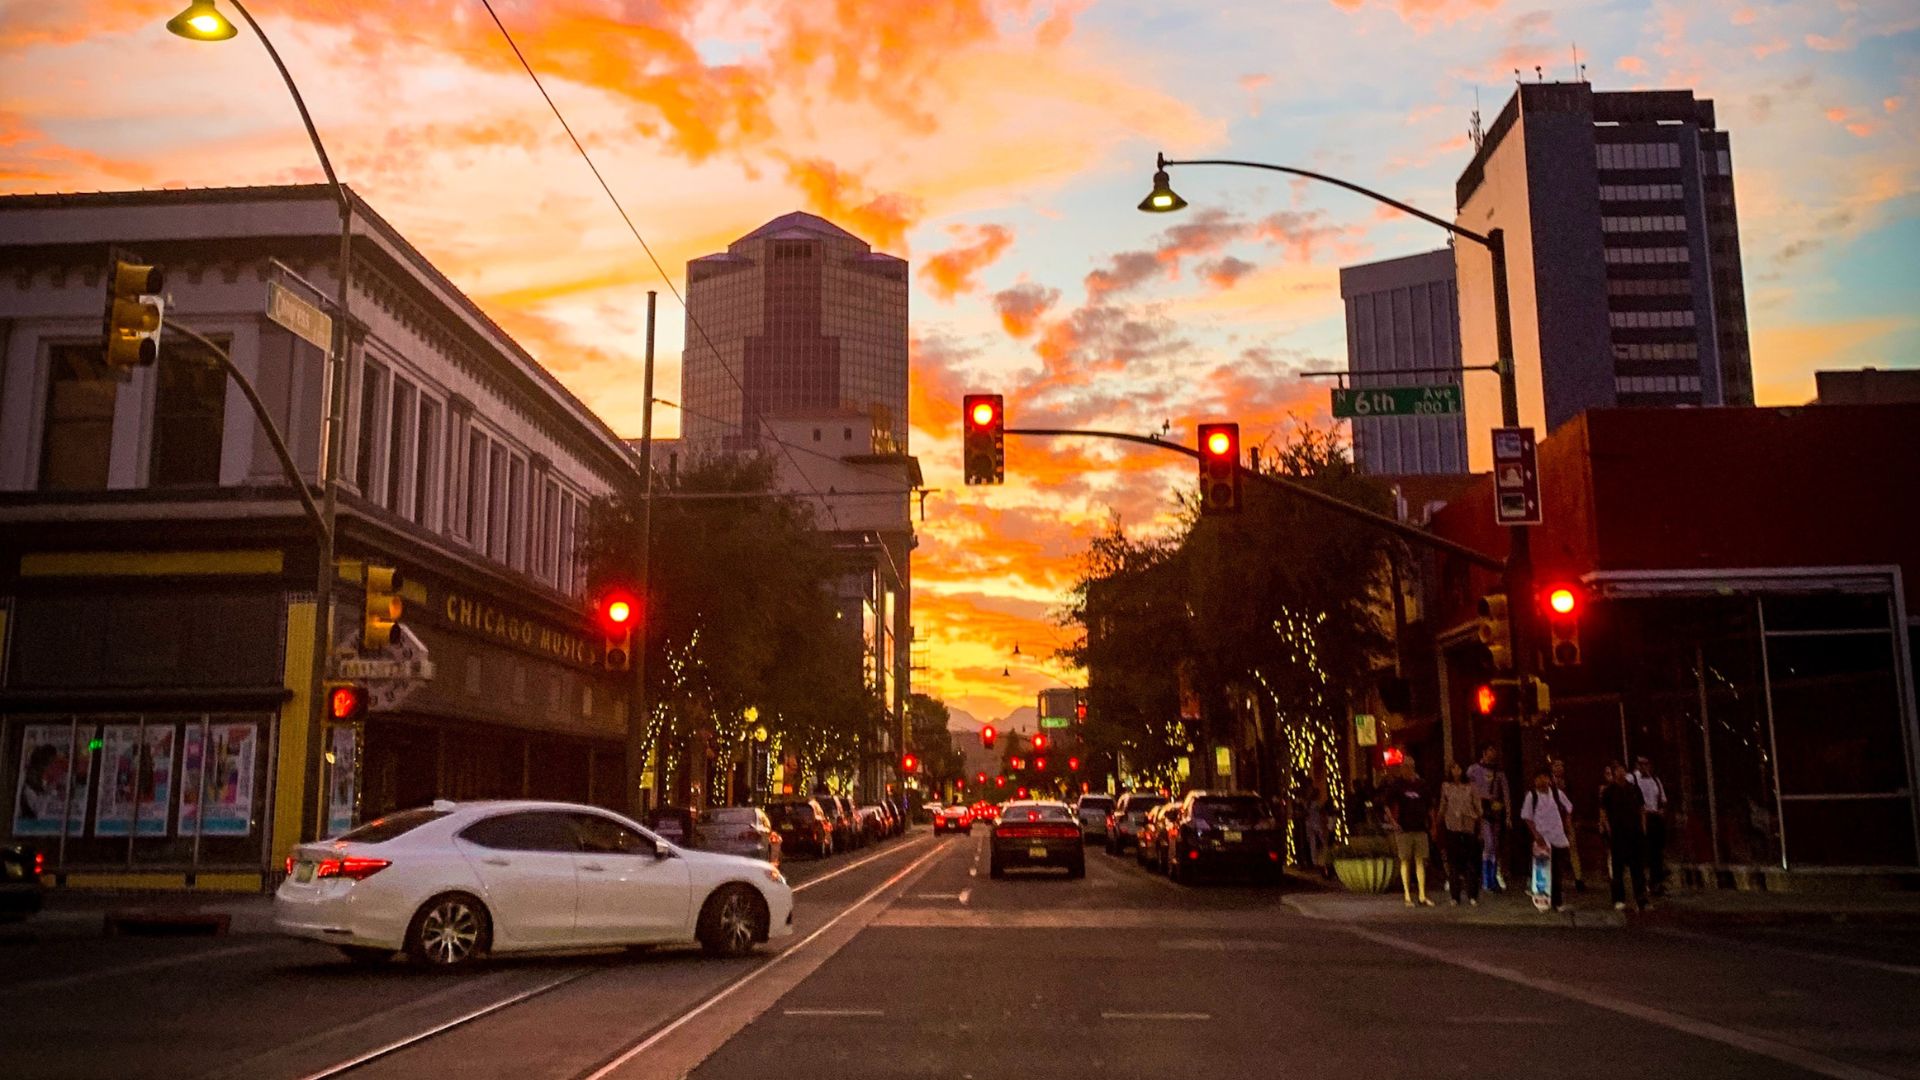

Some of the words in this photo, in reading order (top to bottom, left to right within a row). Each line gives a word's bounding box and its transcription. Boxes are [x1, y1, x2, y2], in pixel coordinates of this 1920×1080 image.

[1337, 390, 1347, 402] N
[1355, 391, 1396, 415] 6th
[1423, 387, 1452, 401] Ave
[446, 594, 533, 644] CHICAGO
[539, 628, 585, 663] MUSIC
